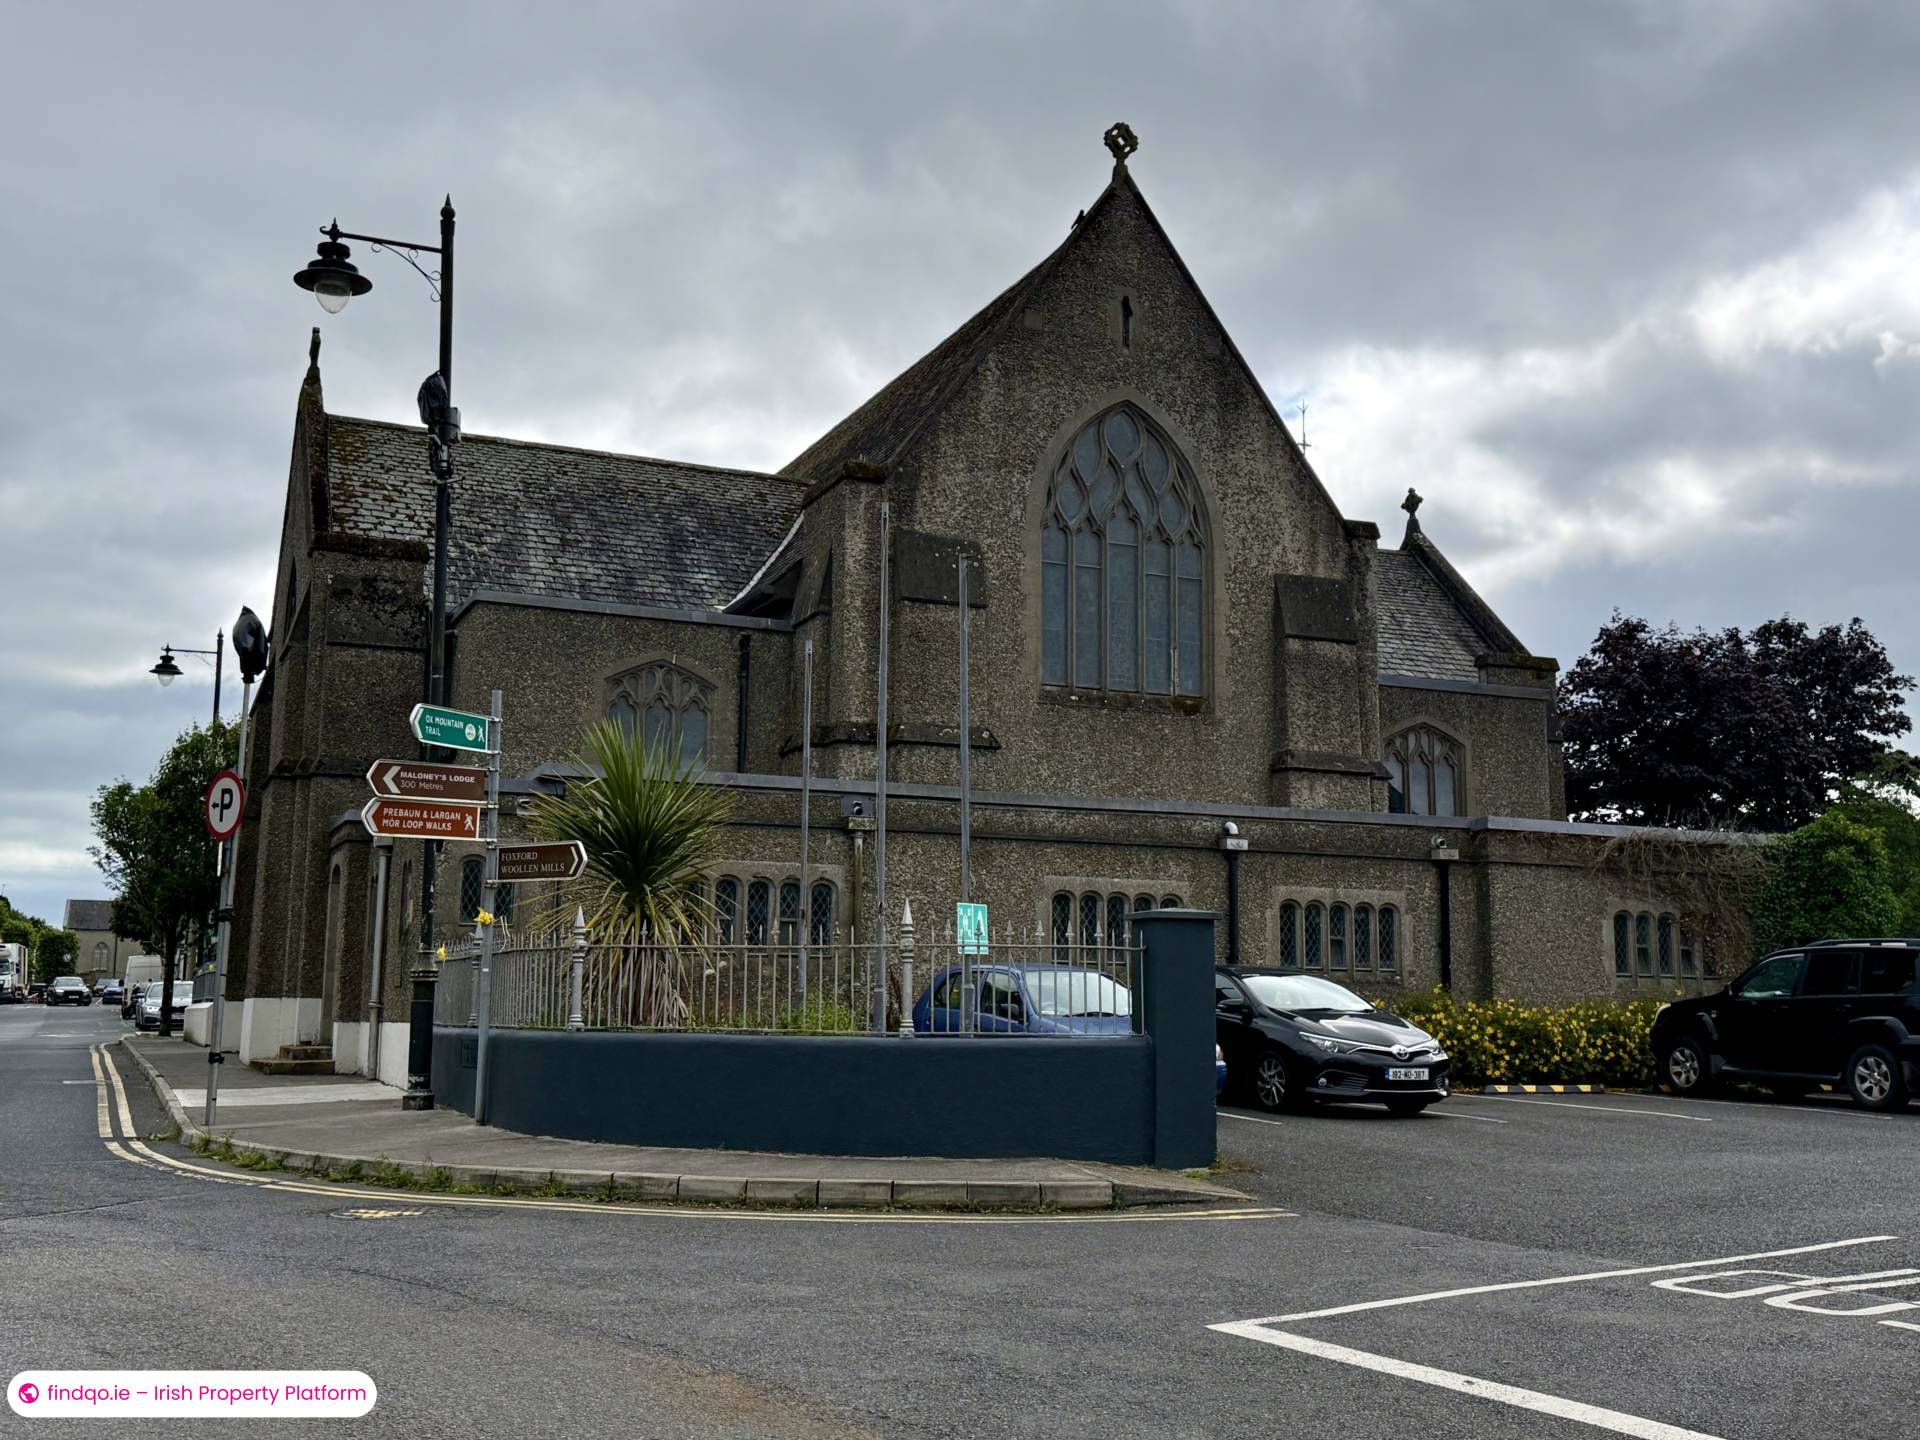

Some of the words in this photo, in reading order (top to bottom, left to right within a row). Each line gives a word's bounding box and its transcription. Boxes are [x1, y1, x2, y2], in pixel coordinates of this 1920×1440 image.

[425, 714, 434, 724] OX
[434, 717, 465, 729] MOUNTAIN
[425, 726, 441, 737] TRAIL
[400, 771, 447, 781] MALONEY'S
[449, 775, 476, 783] LODGE
[400, 780, 416, 789] 300
[419, 781, 444, 791] Metres
[219, 788, 233, 822] P
[383, 807, 421, 818] PREBAUN
[422, 809, 428, 817] &
[430, 811, 461, 821] LARGAN
[402, 819, 424, 829] LOOP
[425, 821, 452, 831] WALKS
[501, 851, 538, 862] FOXFORD
[501, 863, 539, 874] WOOLLEN
[541, 863, 565, 872] MILLS
